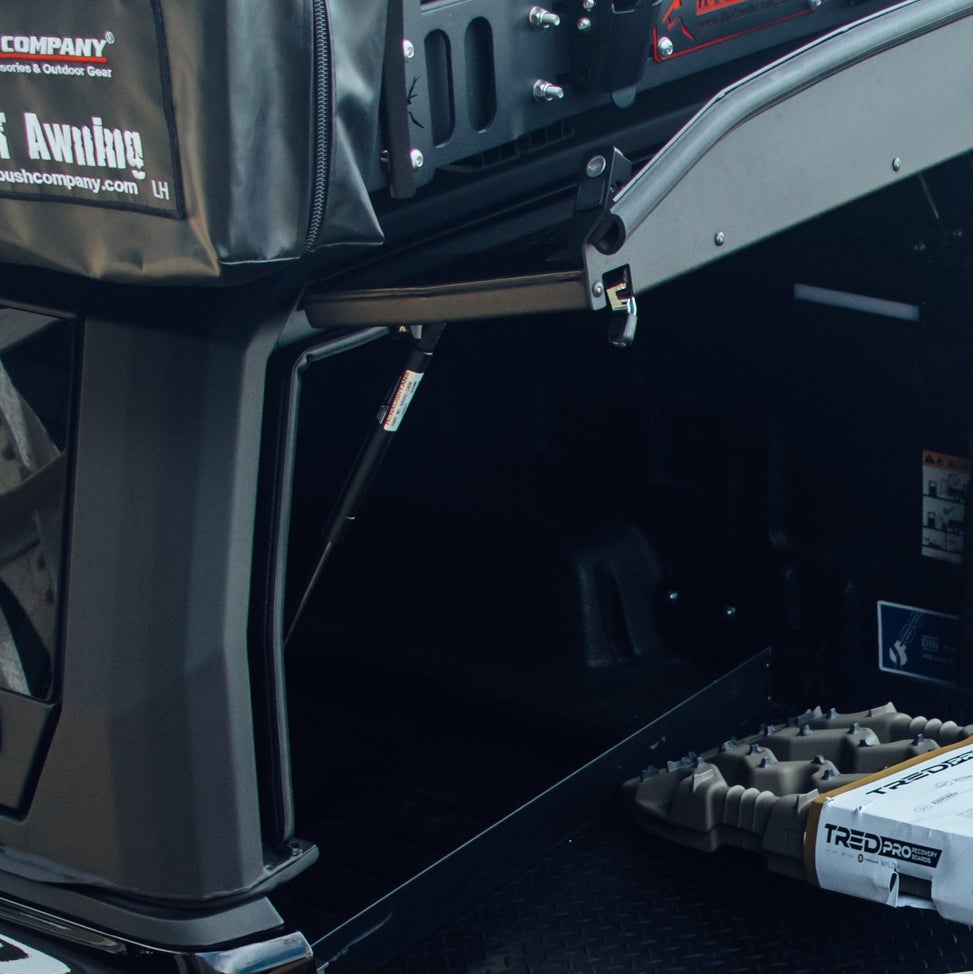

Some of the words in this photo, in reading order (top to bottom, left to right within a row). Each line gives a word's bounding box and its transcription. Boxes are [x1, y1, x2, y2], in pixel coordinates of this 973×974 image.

[33, 63, 41, 74] &
[43, 63, 84, 76] Outdoor
[87, 66, 112, 78] Gear
[24, 112, 146, 180] Awning
[152, 180, 170, 200] LH
[865, 760, 951, 795] TRED
[824, 823, 881, 855] TRED
[882, 841, 912, 859] PRO
[911, 847, 938, 857] RECOVERY
